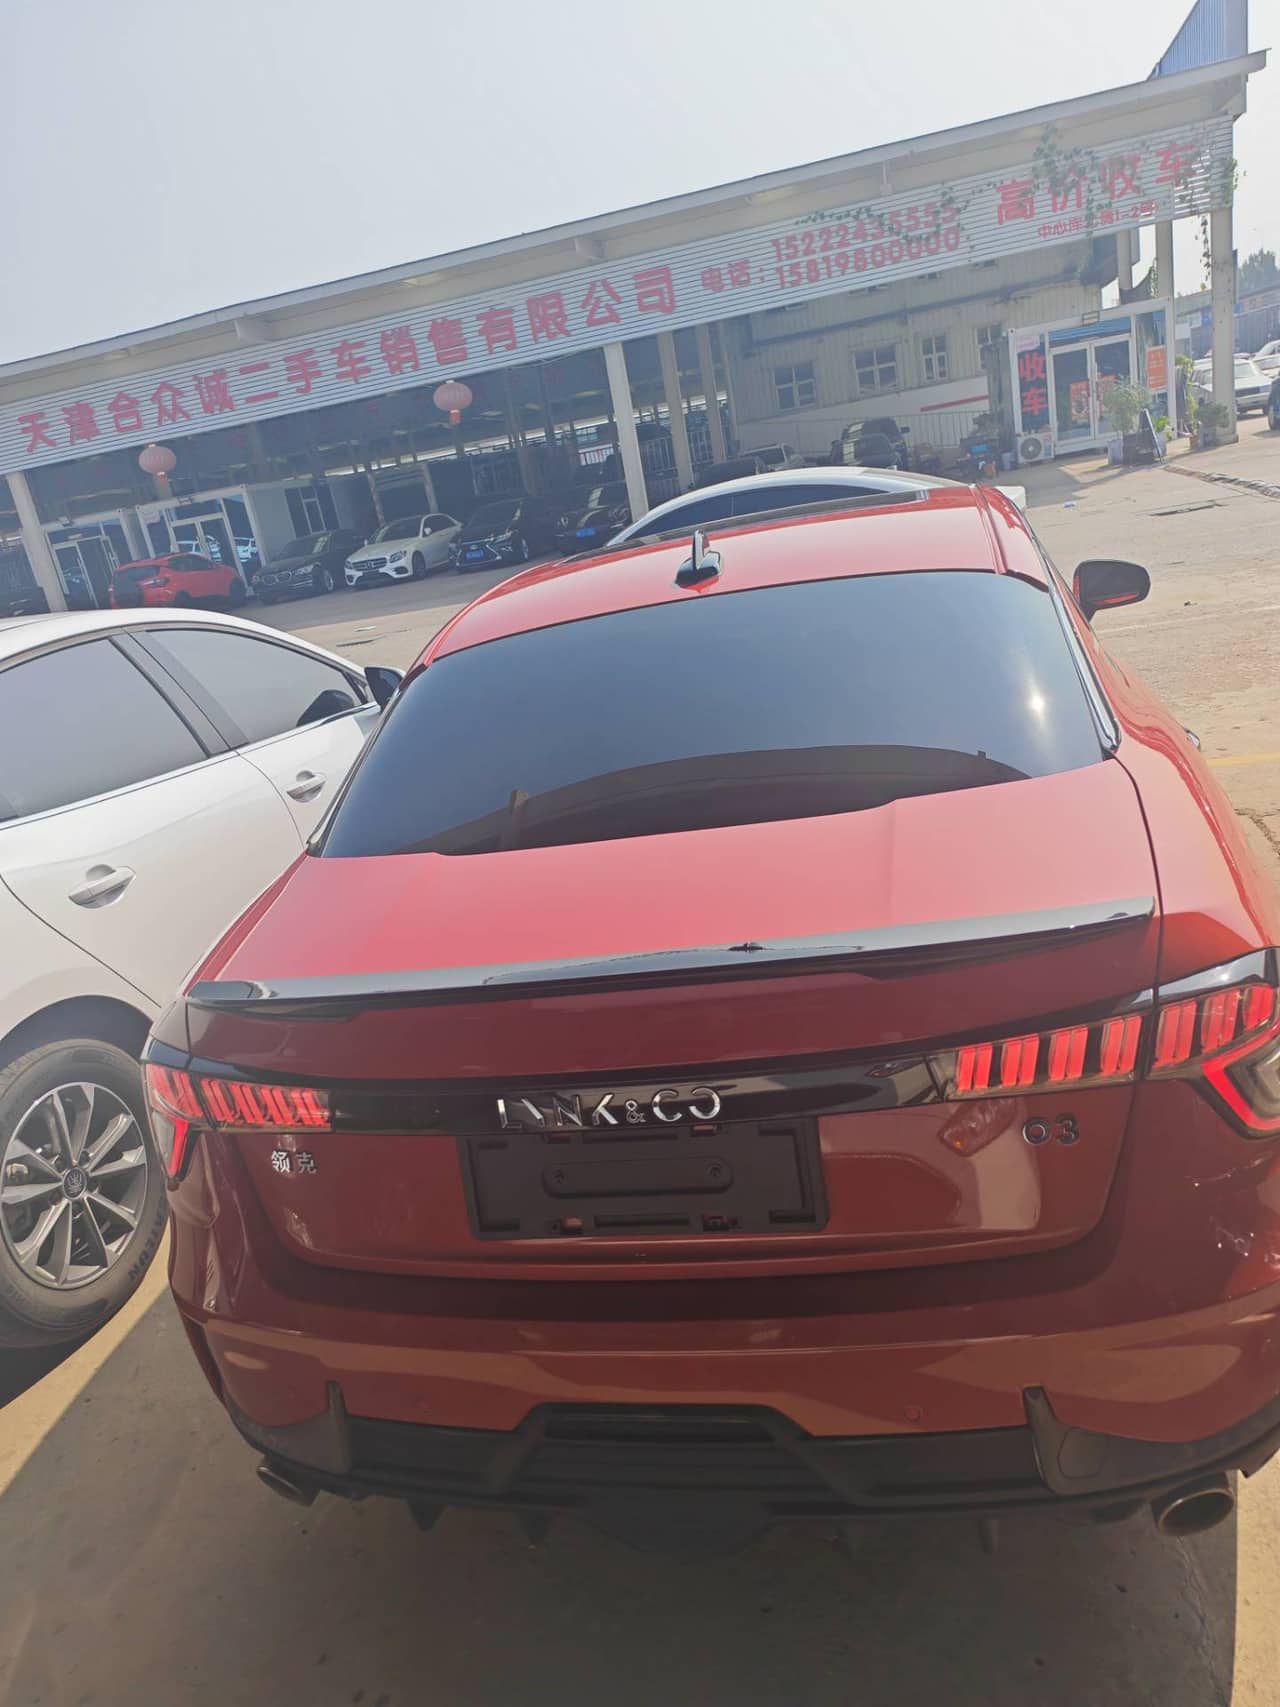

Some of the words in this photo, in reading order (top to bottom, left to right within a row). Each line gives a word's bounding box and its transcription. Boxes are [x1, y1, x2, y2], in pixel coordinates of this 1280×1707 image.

[17, 266, 677, 454] 天津合众诚二手车销售有限公司
[271, 1150, 317, 1174] 领克
